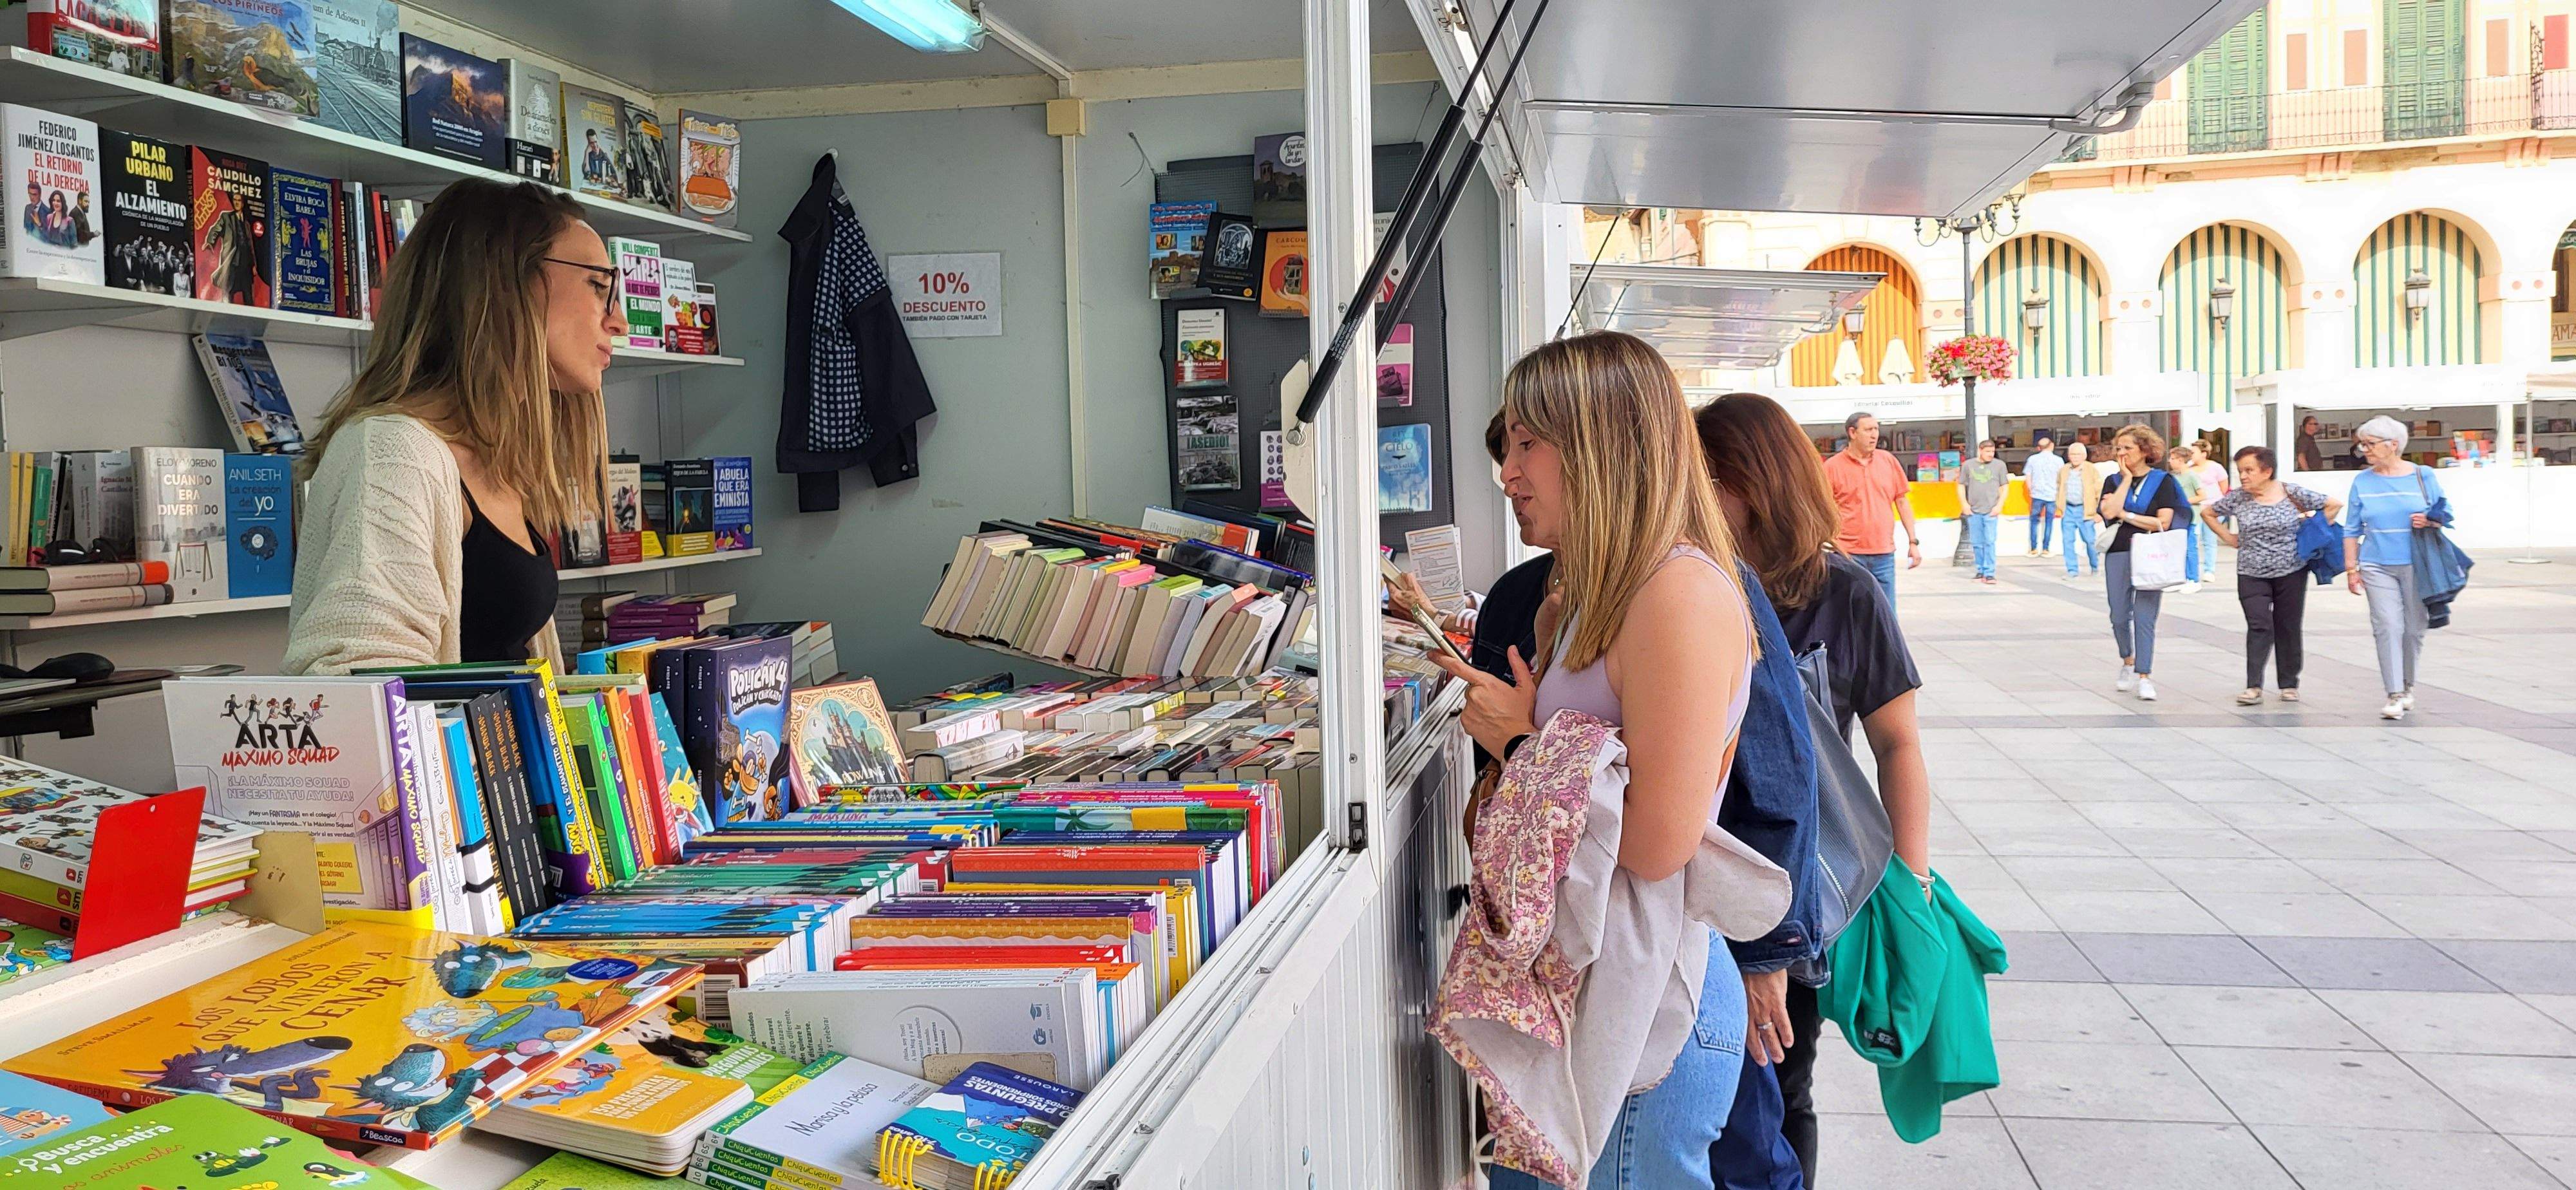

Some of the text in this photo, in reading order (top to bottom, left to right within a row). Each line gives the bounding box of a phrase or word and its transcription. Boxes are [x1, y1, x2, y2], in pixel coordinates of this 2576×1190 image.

[235, 1, 284, 17] PIRINEOS
[335, 9, 359, 26] Adioses
[39, 120, 77, 141] FEDERICO
[18, 133, 95, 162] JIMÉNEZ LOSANTOS
[131, 141, 166, 164] PILAR
[516, 141, 533, 153] Harari
[34, 153, 83, 176] EL RETORNO
[126, 157, 174, 182] URBANO
[207, 165, 261, 185] CAUDILLO
[28, 169, 90, 194] DE LA DERECHA
[146, 180, 160, 196] EL
[207, 176, 261, 199] SÁNCHEZ
[115, 191, 187, 220] ALZAMIENTO
[284, 192, 325, 208] ELVIRA ROCA
[295, 203, 316, 216] BAREA
[300, 249, 312, 258] LAS
[621, 241, 633, 252] WILL
[295, 256, 317, 269] BRUJAS
[623, 255, 660, 284] MIRA
[287, 272, 326, 286] INQUISIDOR
[918, 272, 969, 294] 10%
[630, 298, 661, 313] EL MUNDO
[904, 301, 985, 313] DESCUENTO
[636, 325, 652, 335] ARTE
[2552, 325, 2576, 341] AMA
[227, 357, 244, 370] 109
[1385, 442, 1414, 452] CIELO
[156, 458, 178, 467] ELOY
[720, 468, 750, 480] ABUELA
[164, 474, 212, 486] CUANDO
[229, 469, 281, 481] ANIL SETH
[719, 480, 750, 492] QUE ERA
[178, 488, 200, 501] ERA
[242, 485, 281, 494] creación
[714, 491, 750, 508] EMINISTA
[254, 496, 274, 516] yo
[730, 658, 788, 697] POLICÁN 4
[732, 694, 753, 712] POLICÁN
[236, 724, 321, 749] ARTA
[478, 714, 497, 777] AMANDA BLACK
[493, 712, 510, 773] AMANDA BLACK
[504, 709, 522, 768] AMANDA BLACK
[222, 746, 340, 771] MÁXIMO SQUAD
[544, 712, 570, 796] DIAMANTITO PERDIDO
[228, 773, 350, 789] ¡LA MÁXIMO SQUAD
[392, 695, 412, 768] ARTA
[410, 822, 426, 865] SQUAD
[841, 766, 885, 784] ROWLING
[227, 788, 355, 802] NECESITA TU AYUDA!
[249, 810, 261, 818] ¡Hay
[269, 809, 300, 818] FANTASMA
[315, 811, 337, 819] colegio!
[77, 870, 84, 884] sm
[72, 891, 82, 910] sm
[175, 962, 331, 1030] LOS LOBOS
[201, 951, 393, 1042] QUE VINIERON A
[280, 975, 416, 1030] CENAR
[766, 1018, 777, 1044] carnaval
[784, 1008, 793, 1039] diferente.
[822, 1017, 831, 1043] celebrar
[57, 1015, 155, 1056] STEVE SMALLMAN
[777, 1020, 786, 1055] disfrazarse
[797, 1030, 806, 1051] quiere
[701, 1044, 759, 1077] PREGUNTAS
[728, 1050, 776, 1081] ANIMALES
[803, 1054, 842, 1079] ChiquiCuentos
[589, 1074, 668, 1116] 150 PREGUNTAS
[763, 1077, 806, 1103] ChiquiCuentos
[969, 1075, 1045, 1105] SORPRENDENTES
[1012, 1073, 1075, 1097] LAROUSSE
[140, 1095, 156, 1105] LOS
[615, 1079, 694, 1120] TUS CONOCIMIENTOS
[963, 1079, 1057, 1115] PREGUNTAS
[604, 1105, 627, 1118] PARA
[718, 1103, 764, 1134] ChiquiCuentos
[785, 1109, 837, 1137] Marisa
[848, 1082, 878, 1104] pelusa
[370, 1129, 404, 1145] Beascoa
[932, 1117, 1035, 1154] respuestas
[957, 1131, 1028, 1160] TODO
[32, 1135, 106, 1161] Busca
[43, 1125, 175, 1175] y encuentra
[711, 1135, 838, 1183] 64 ChiquiCuentos ChiquiCuentos
[91, 1144, 185, 1181] animales
[695, 1158, 762, 1187] 66 ChiquiCuentos
[701, 1145, 827, 1190] 65 ChiquiCuentos ChiquiCuentos
